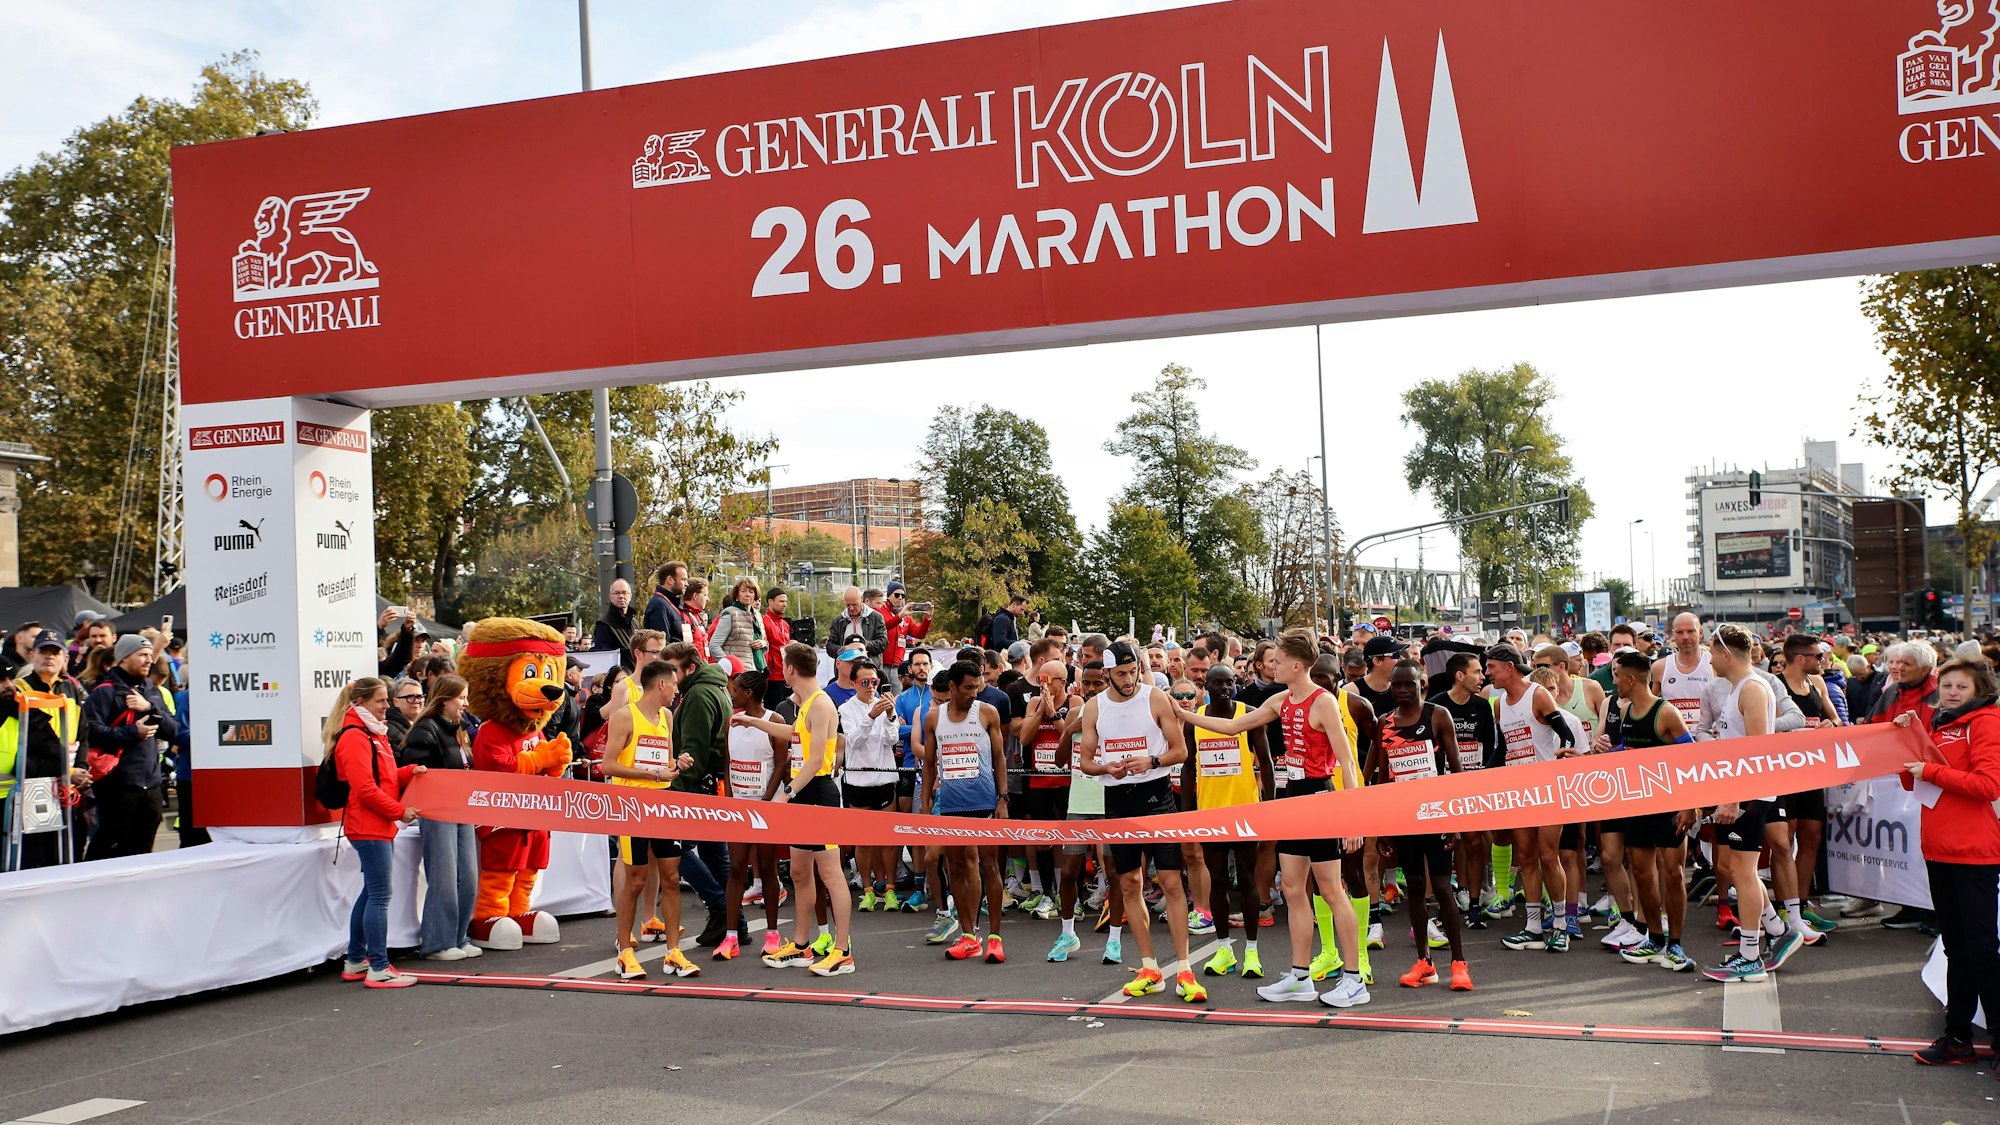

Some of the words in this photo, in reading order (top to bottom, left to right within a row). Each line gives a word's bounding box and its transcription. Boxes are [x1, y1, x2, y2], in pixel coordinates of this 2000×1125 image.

[1905, 56, 1923, 68] PAX
[1928, 54, 1948, 62] VAN
[1905, 64, 1924, 76] TIBI
[1929, 62, 1950, 70] GELI
[1905, 72, 1926, 84] MAR
[1929, 70, 1946, 78] STA
[1905, 82, 1918, 92] CE
[1920, 79, 1926, 88] E
[1930, 79, 1951, 88] MEVS
[715, 90, 997, 178] GENERALI
[1012, 45, 1332, 189] KÖLN
[750, 198, 902, 298] 26.
[927, 178, 1336, 280] MARATHON
[234, 295, 381, 340] GENERALI
[214, 425, 281, 445] GENERALI
[316, 430, 365, 450] GENERALI
[232, 475, 262, 486] Rhein
[329, 476, 352, 489] Rhein
[232, 486, 272, 499] Energie
[330, 488, 360, 502] Energie
[214, 534, 254, 551] PUMA
[317, 533, 347, 550] PUMA
[215, 572, 268, 602] Reissdorf
[318, 573, 357, 598] Reissdorf
[226, 632, 276, 650] pixum
[326, 630, 363, 648] pixum
[210, 673, 260, 692] REWE
[238, 724, 268, 742] AWB
[1114, 740, 1146, 748] GENERALI
[1394, 744, 1427, 756] GENERALI
[651, 751, 660, 760] 16
[1213, 753, 1224, 762] 14
[1448, 785, 1554, 816] GENERALI
[1556, 761, 1675, 809] KÖLN
[1675, 746, 1826, 785] MARATHON
[490, 792, 562, 812] GENERALI
[564, 790, 643, 823] KÖLN
[643, 802, 745, 824] MARATHON
[918, 826, 1004, 838] GENERALI
[1101, 826, 1231, 840] MARATHON
[1827, 812, 1908, 854] ixum
[780, 952, 804, 962] NITRO
[1736, 962, 1760, 973] HOKA
